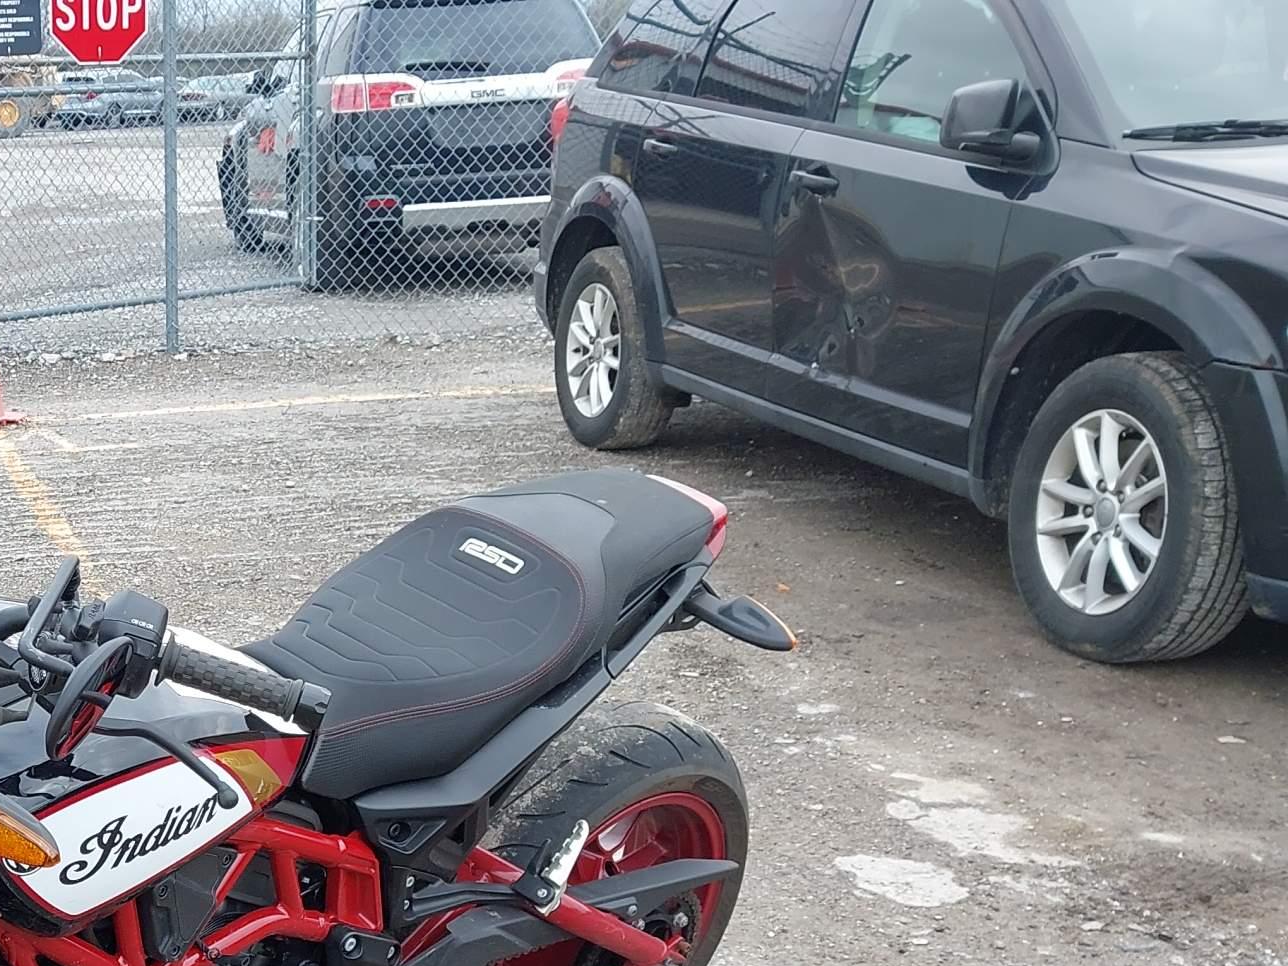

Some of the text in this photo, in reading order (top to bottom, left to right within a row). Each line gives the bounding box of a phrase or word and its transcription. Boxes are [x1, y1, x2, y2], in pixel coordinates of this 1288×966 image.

[55, 0, 142, 31] STOP
[470, 88, 505, 98] GMC
[59, 792, 219, 885] Indian
